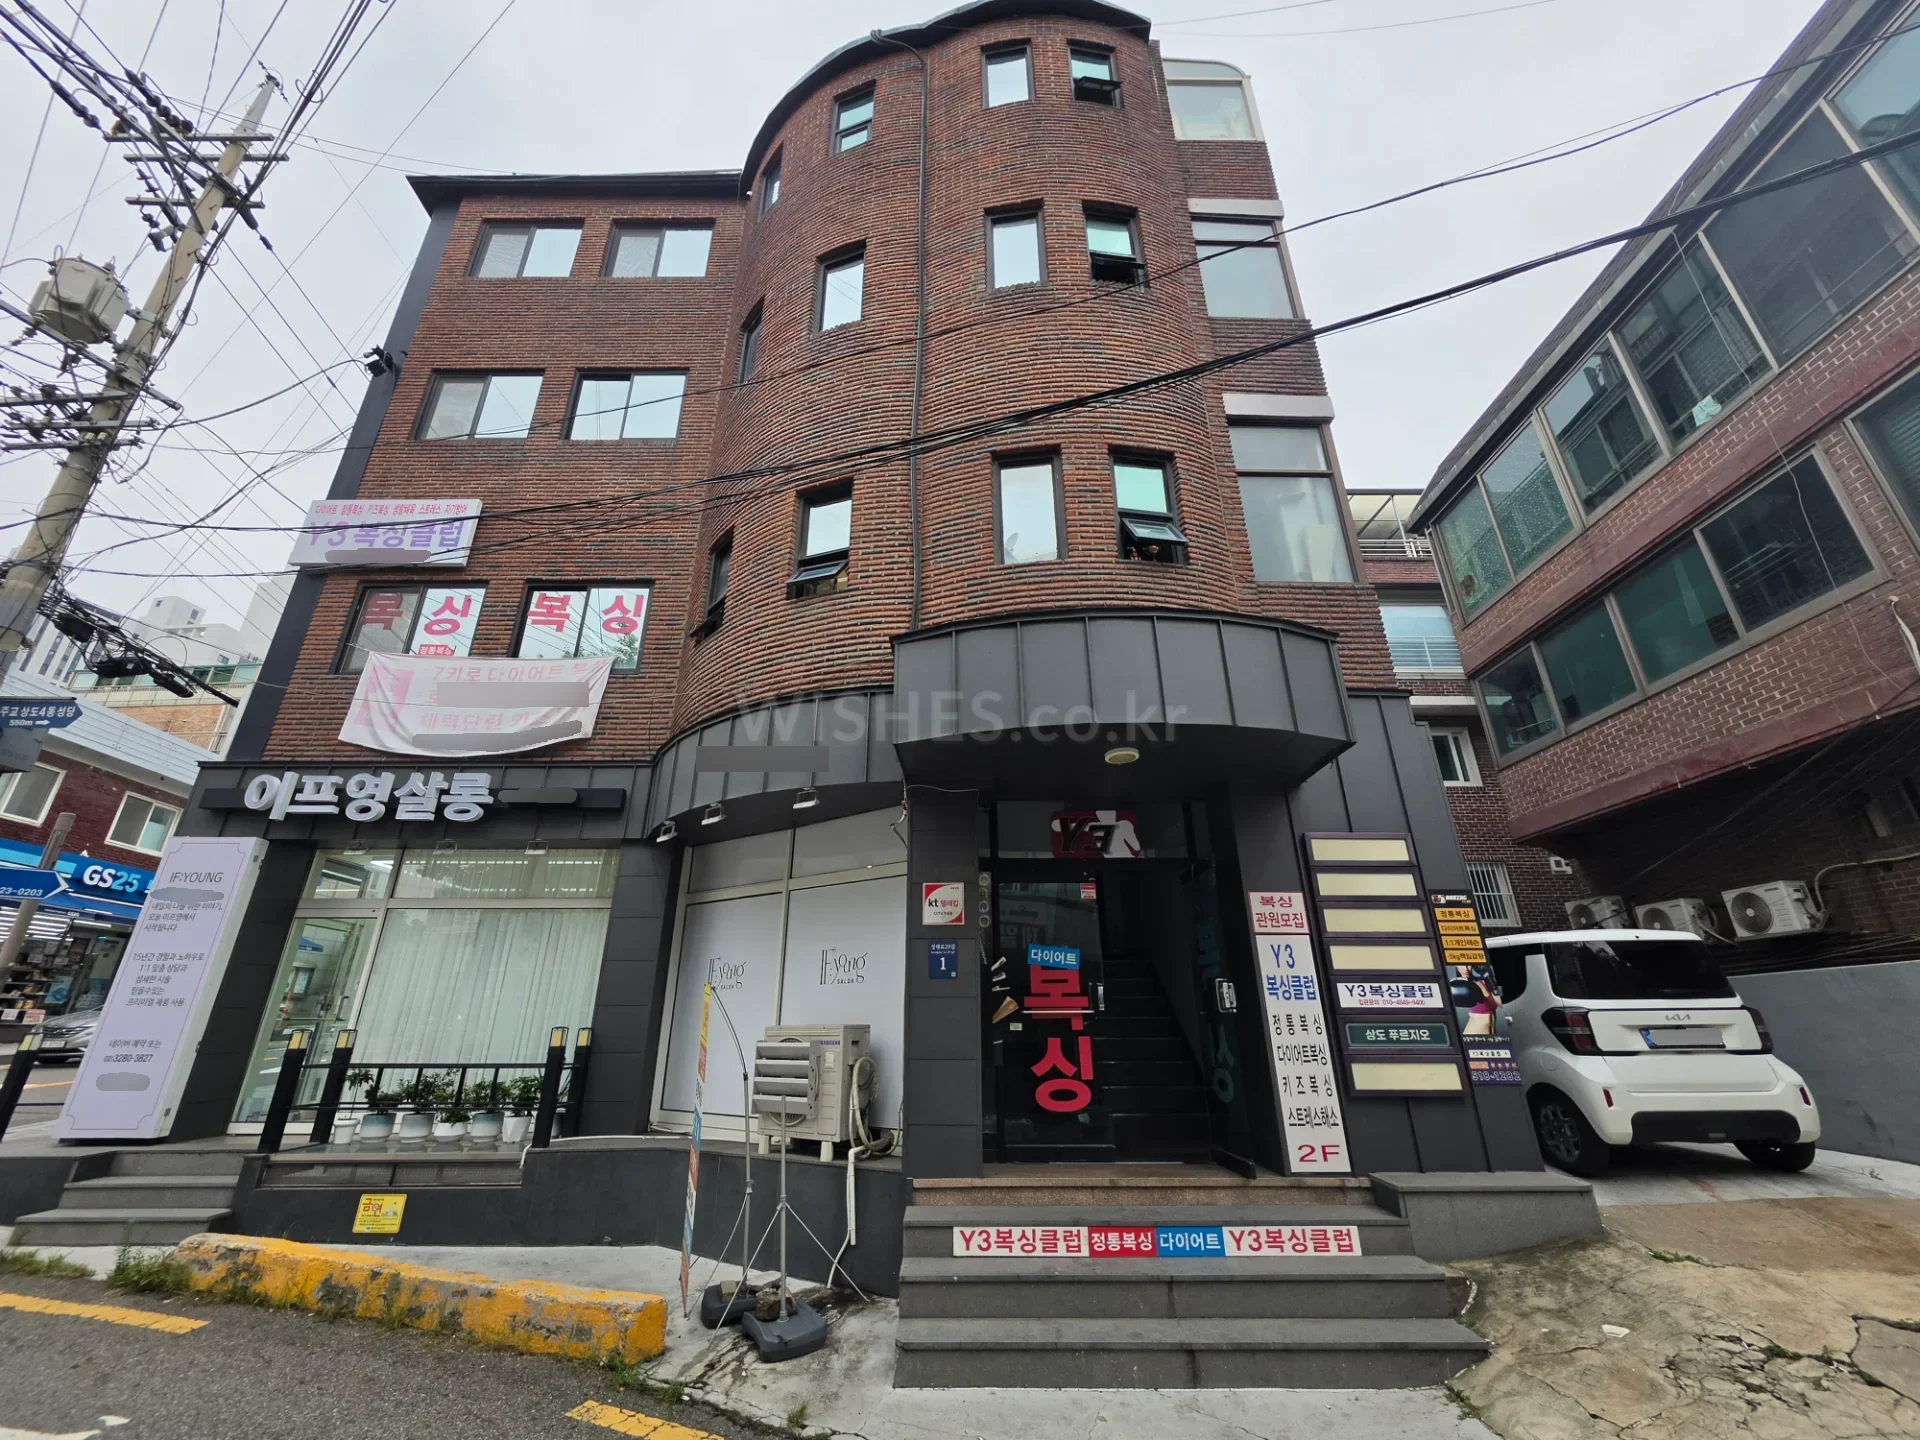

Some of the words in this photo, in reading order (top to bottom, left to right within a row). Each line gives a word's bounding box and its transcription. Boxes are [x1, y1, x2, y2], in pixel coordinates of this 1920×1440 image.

[315, 504, 338, 515] 다이어트
[418, 504, 441, 515] 스트레스
[244, 771, 494, 822] 이프영살롱
[83, 865, 141, 893] GS25
[169, 872, 224, 883] IF:YOUNG
[928, 898, 939, 908] kt
[1260, 896, 1293, 908] 복싱
[1256, 912, 1304, 928] 관원모집
[1440, 910, 1470, 918] 정통복싱
[939, 957, 947, 970] 1
[1030, 949, 1078, 965] 다이어트
[1270, 944, 1296, 969] Y3
[1266, 974, 1317, 1001] 복싱클럽
[1365, 1028, 1387, 1041] 상도
[1388, 1028, 1431, 1041] 푸르지오
[1277, 1043, 1328, 1066] 다이어트복싱
[1472, 1070, 1521, 1081] 518-1282
[1288, 1107, 1340, 1129] 스트레스해소
[1297, 1144, 1341, 1163] 2F
[959, 1229, 1083, 1254] Y3복싱클럽
[1091, 1231, 1153, 1251] 정통복싱
[1159, 1231, 1221, 1251] 다이어트
[1228, 1228, 1354, 1254] Y3복싱클럽
